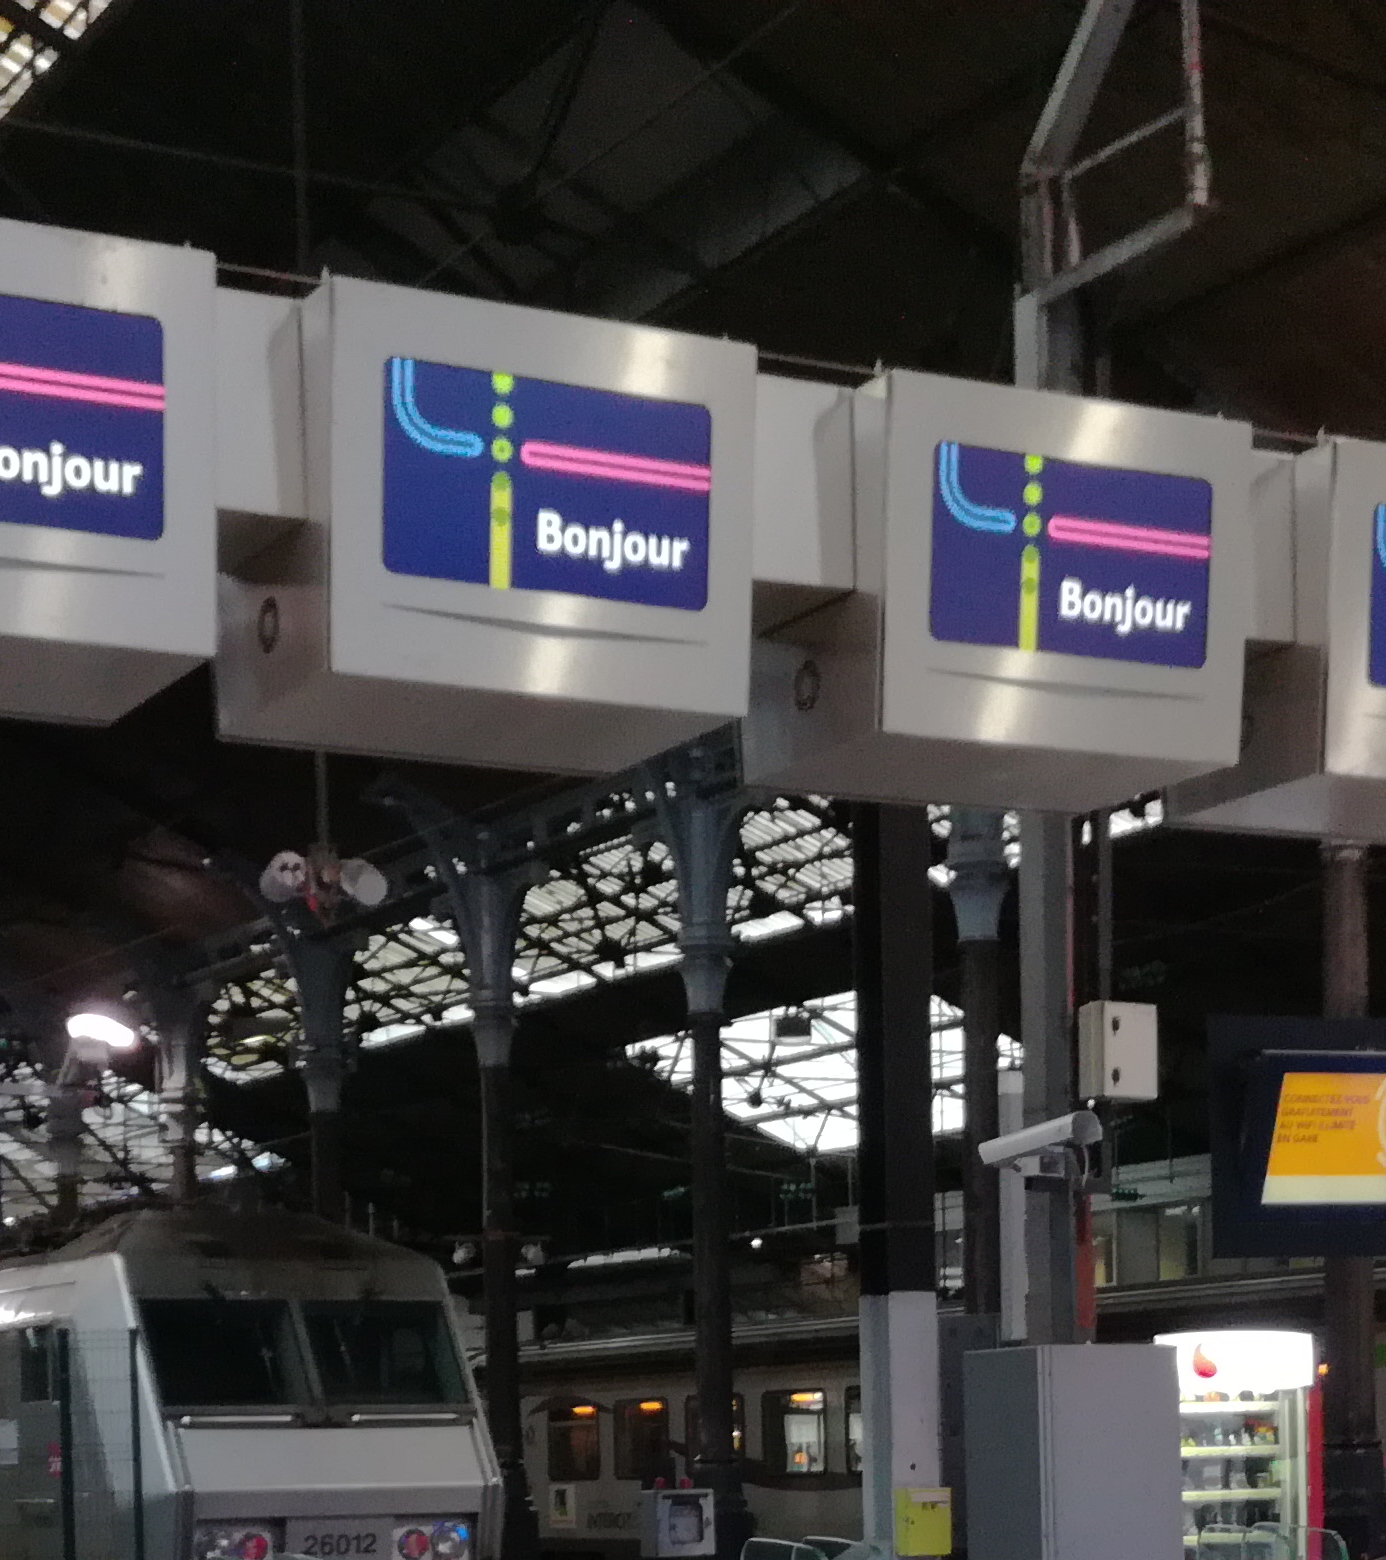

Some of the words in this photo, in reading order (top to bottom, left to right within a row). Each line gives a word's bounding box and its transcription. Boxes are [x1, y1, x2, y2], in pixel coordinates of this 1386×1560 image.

[536, 510, 690, 572] Bonjour
[1059, 578, 1191, 635] Bonjour
[303, 1532, 377, 1556] 26012
